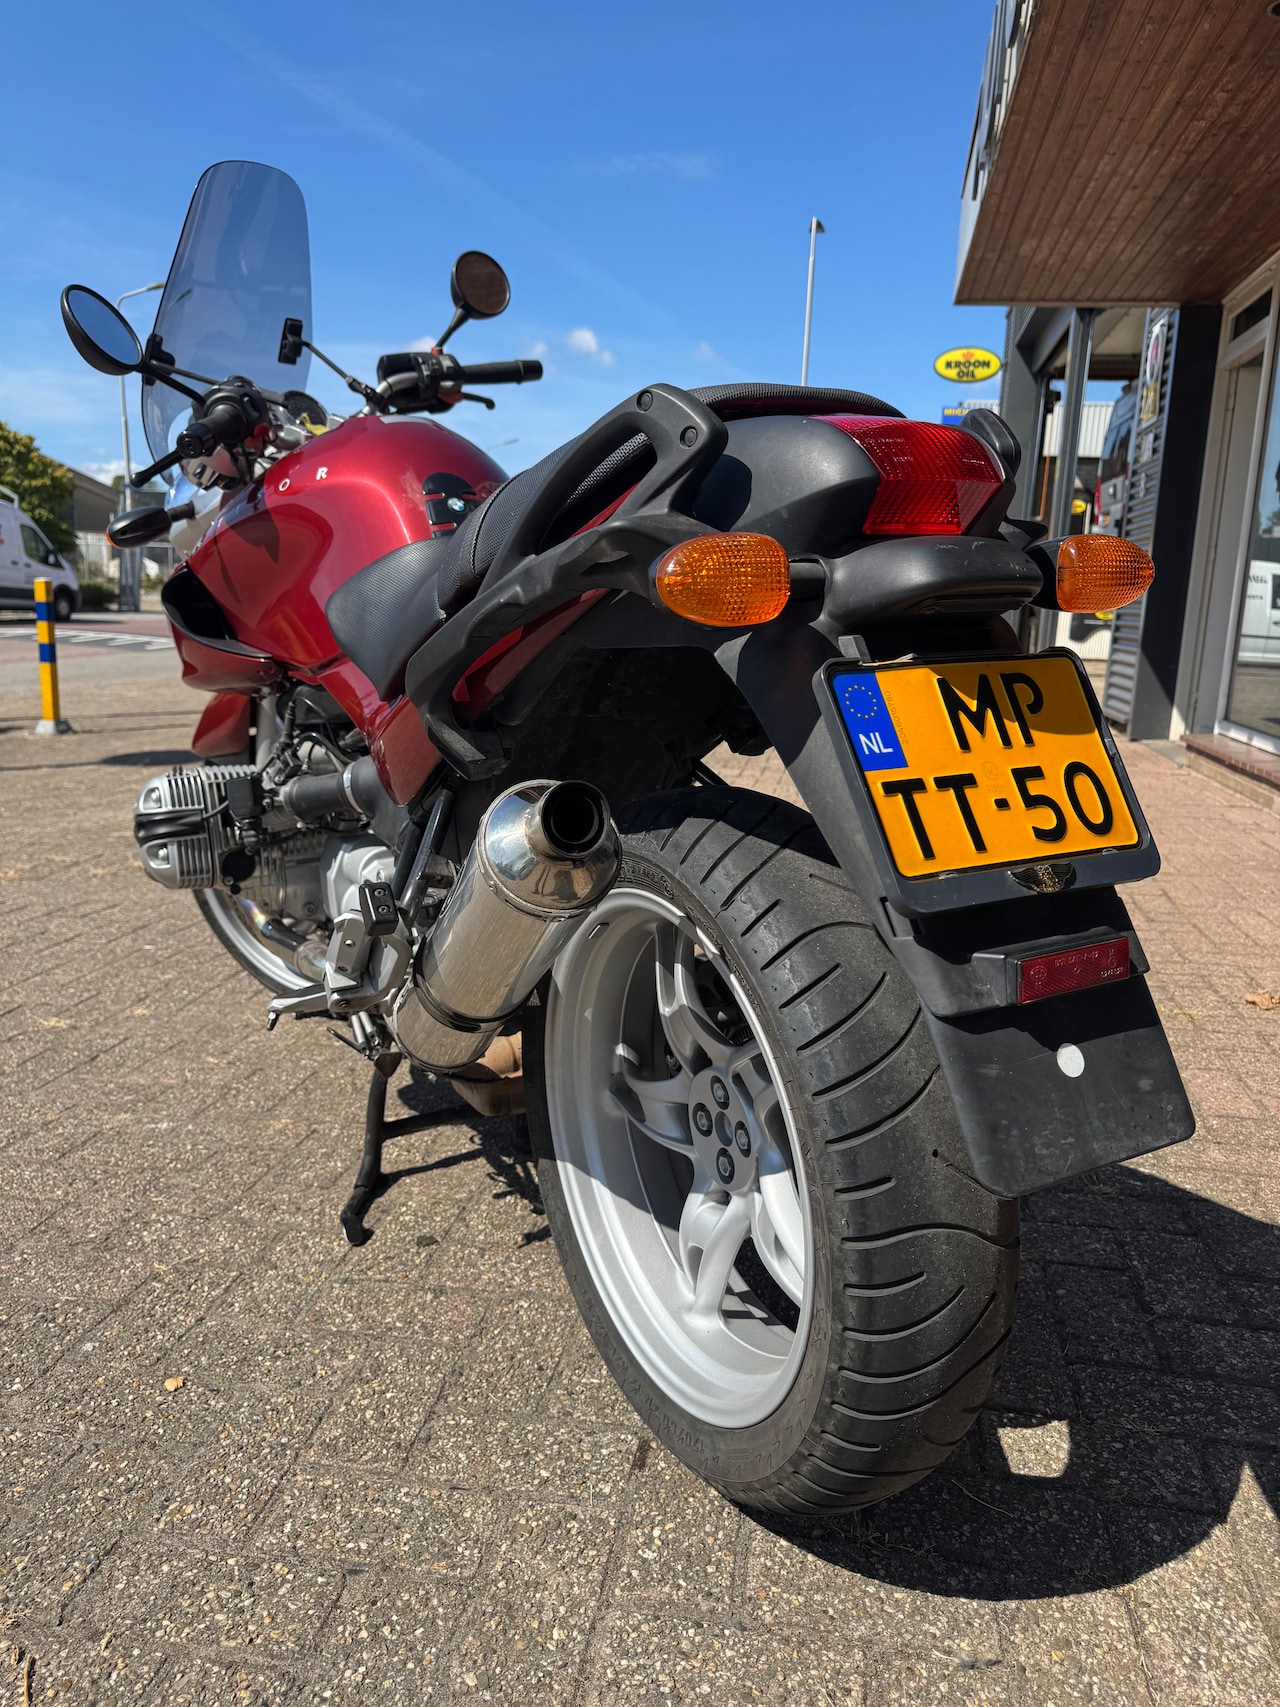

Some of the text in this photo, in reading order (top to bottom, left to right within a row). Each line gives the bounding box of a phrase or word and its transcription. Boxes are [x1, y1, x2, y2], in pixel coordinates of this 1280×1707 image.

[945, 360, 990, 369] KROON
[957, 369, 976, 379] OIL
[936, 672, 1044, 752] MP
[858, 732, 894, 756] NL
[880, 761, 1113, 861] TT-50
